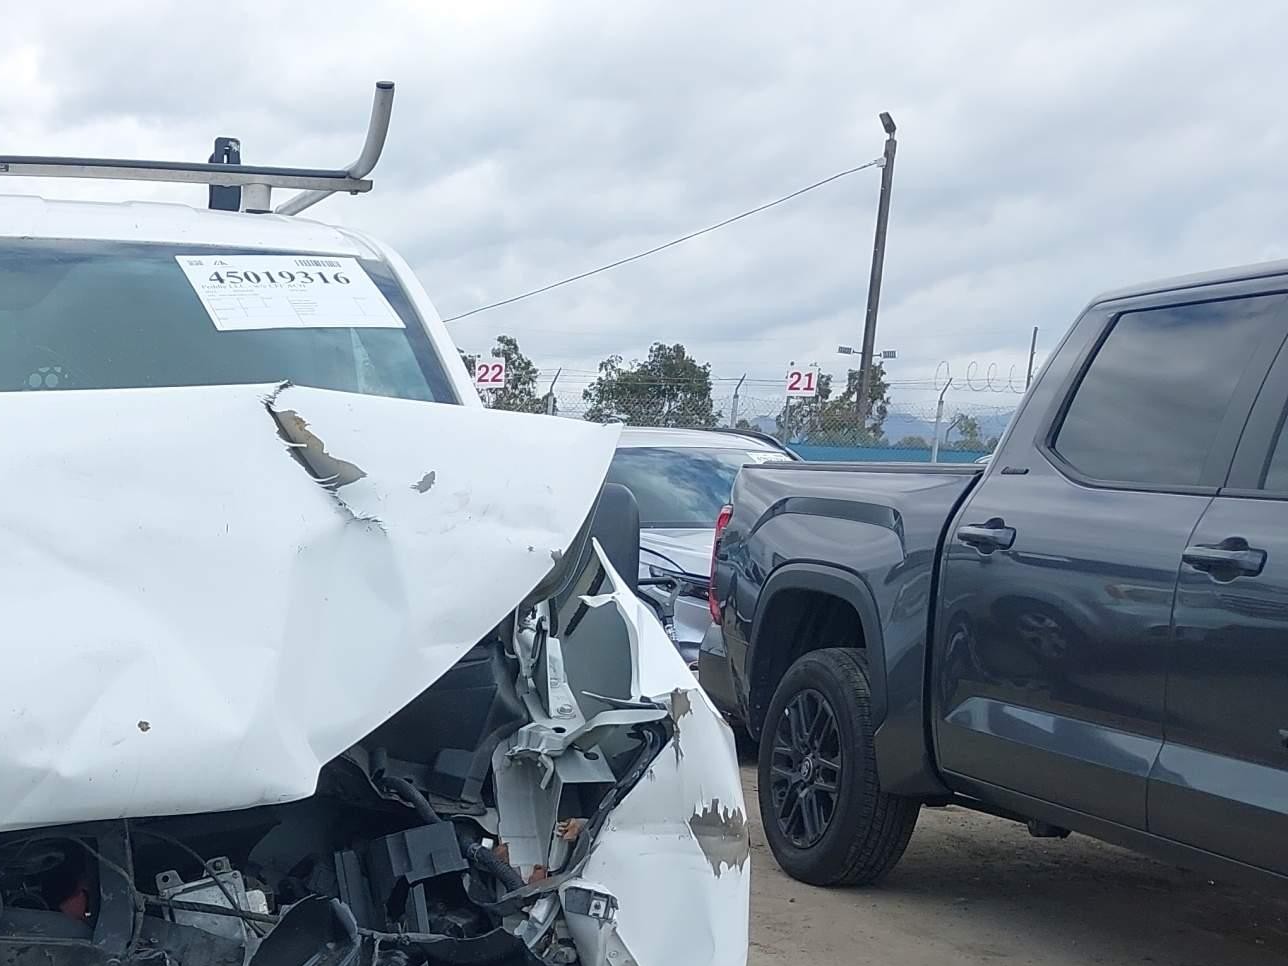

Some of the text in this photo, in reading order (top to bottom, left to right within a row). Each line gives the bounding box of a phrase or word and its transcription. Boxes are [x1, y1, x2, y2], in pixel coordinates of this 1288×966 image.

[209, 271, 351, 285] 45019316
[477, 364, 504, 383] 22
[788, 371, 815, 391] 21
